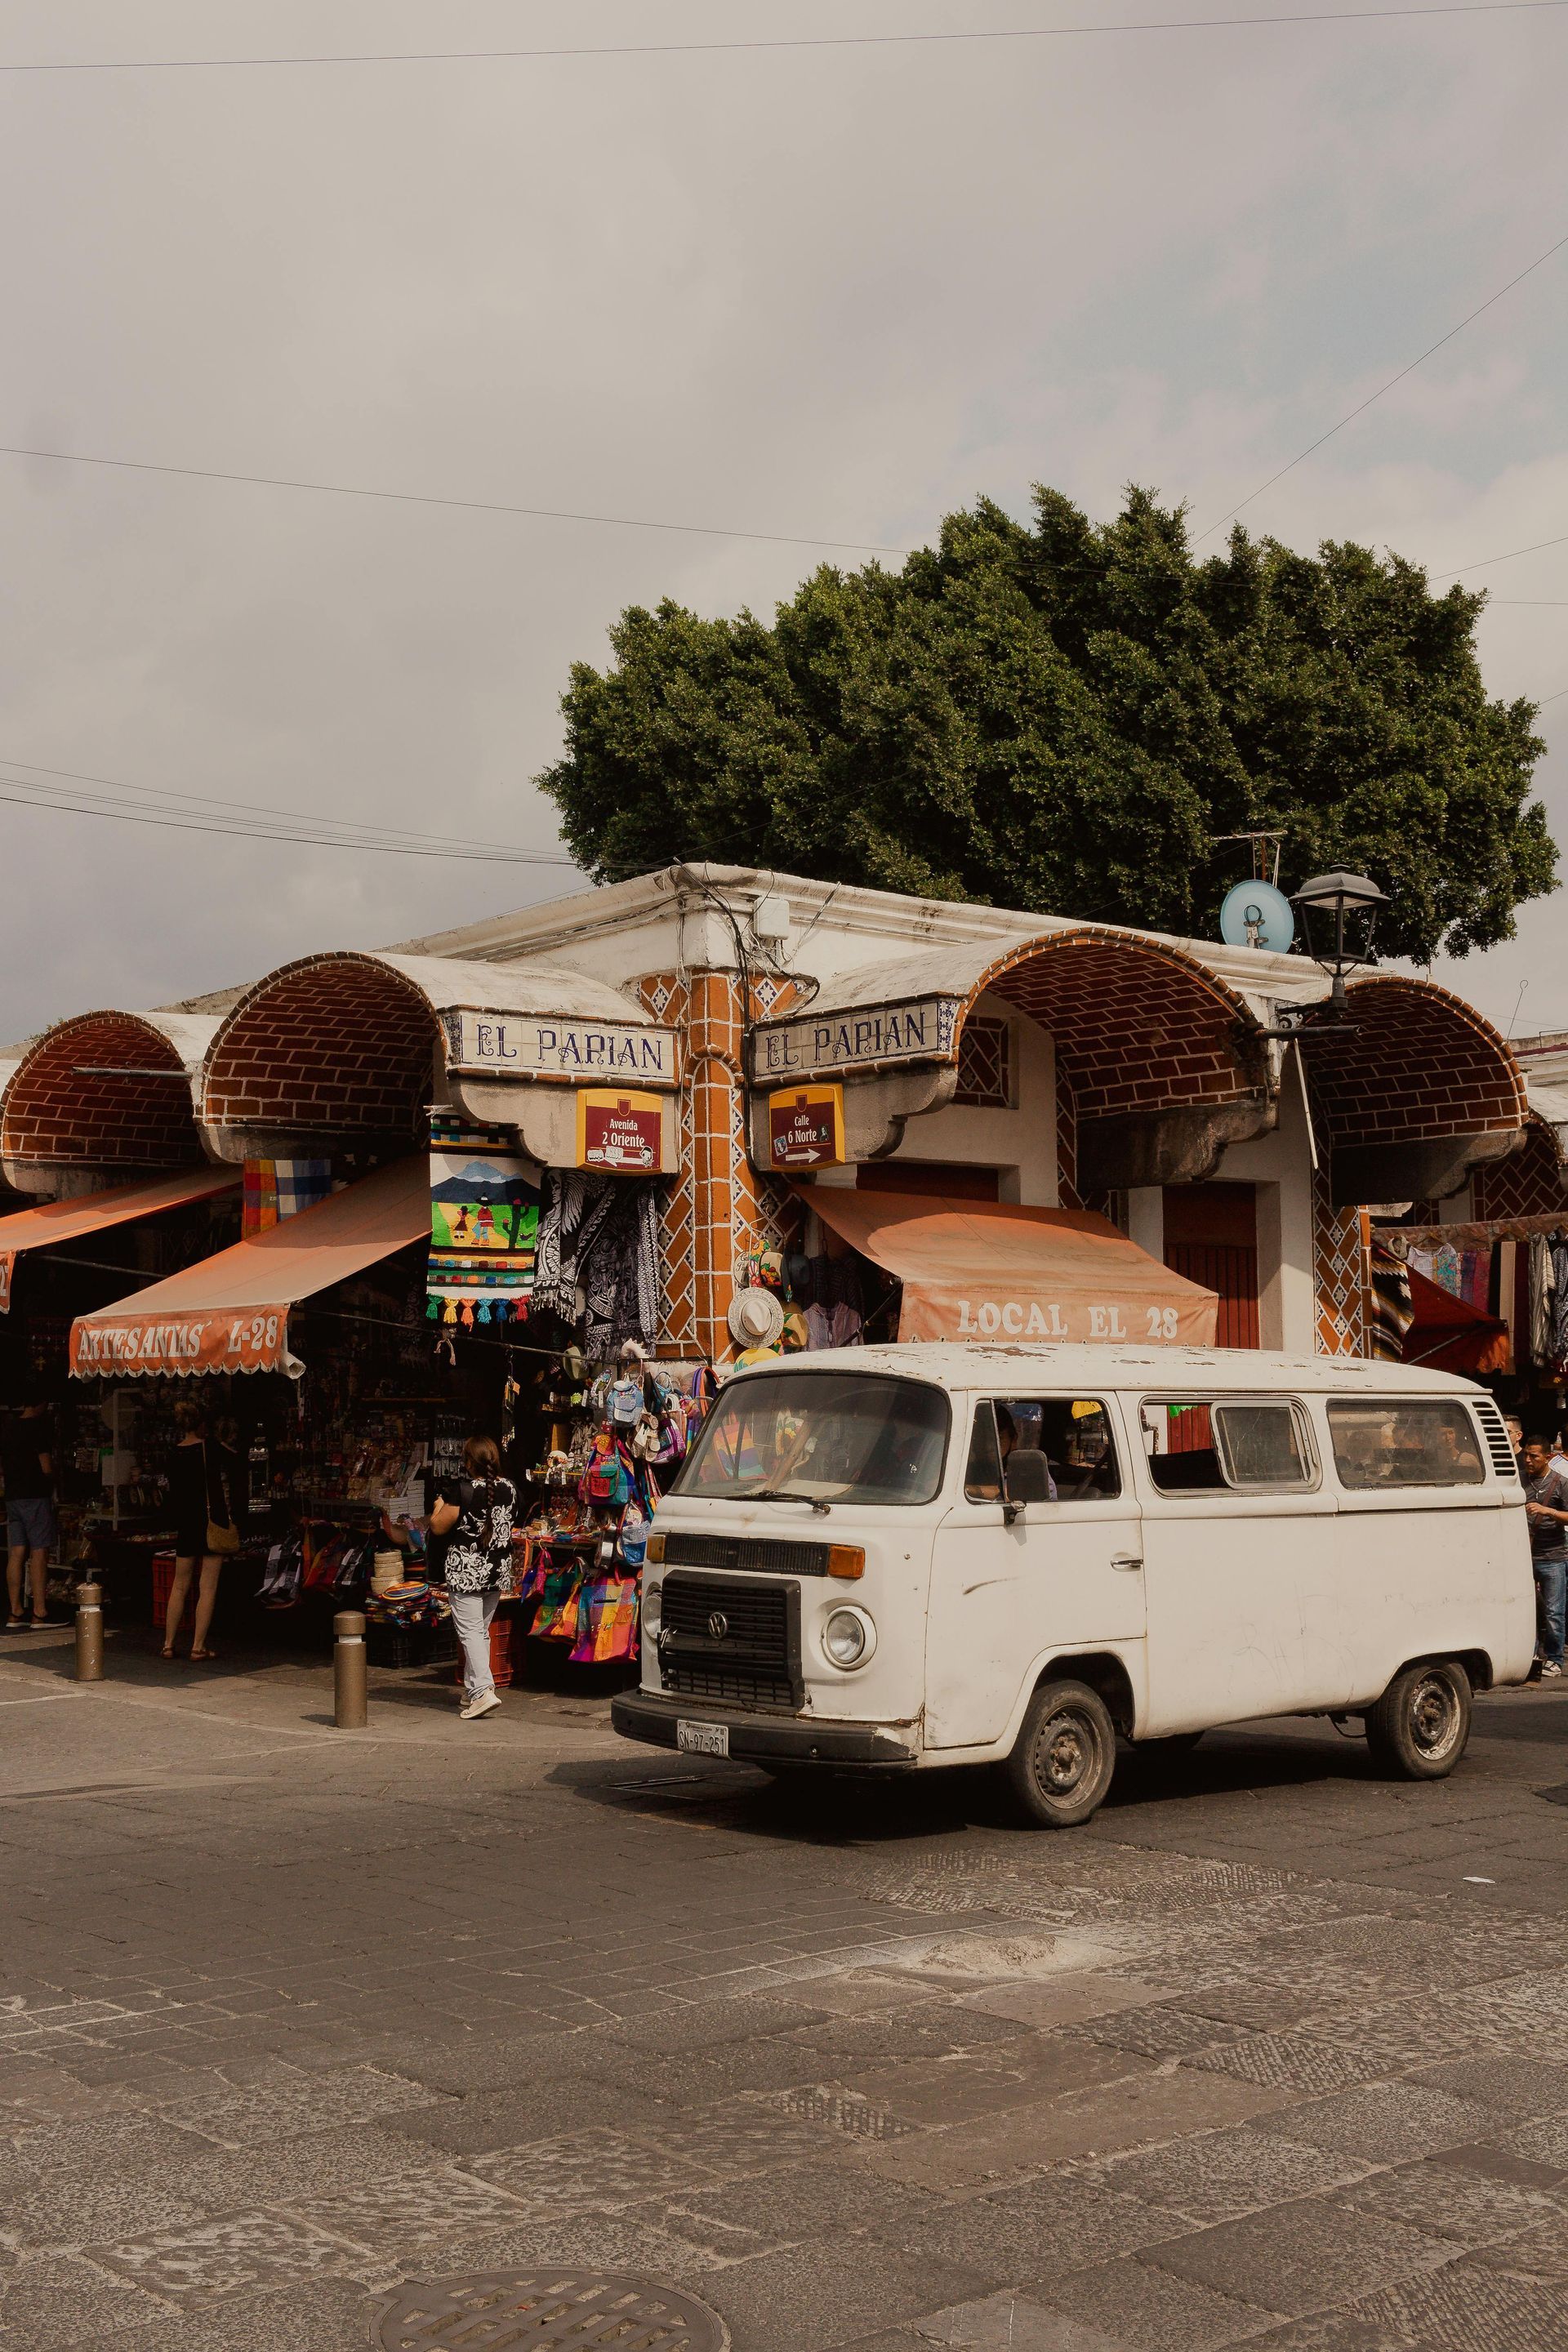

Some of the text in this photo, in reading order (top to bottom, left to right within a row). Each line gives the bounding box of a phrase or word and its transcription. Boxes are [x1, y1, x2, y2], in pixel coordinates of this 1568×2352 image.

[476, 1024, 663, 1070] EL PARIAN
[765, 1012, 925, 1068] EL PARIAN
[609, 1118, 638, 1131] Avenida
[795, 1115, 809, 1126] Calle
[602, 1131, 645, 1147] 2 Oriente
[788, 1129, 817, 1143] 6 Norte
[957, 1300, 1178, 1339] LOCAL EL 28
[228, 1316, 278, 1352] L-28
